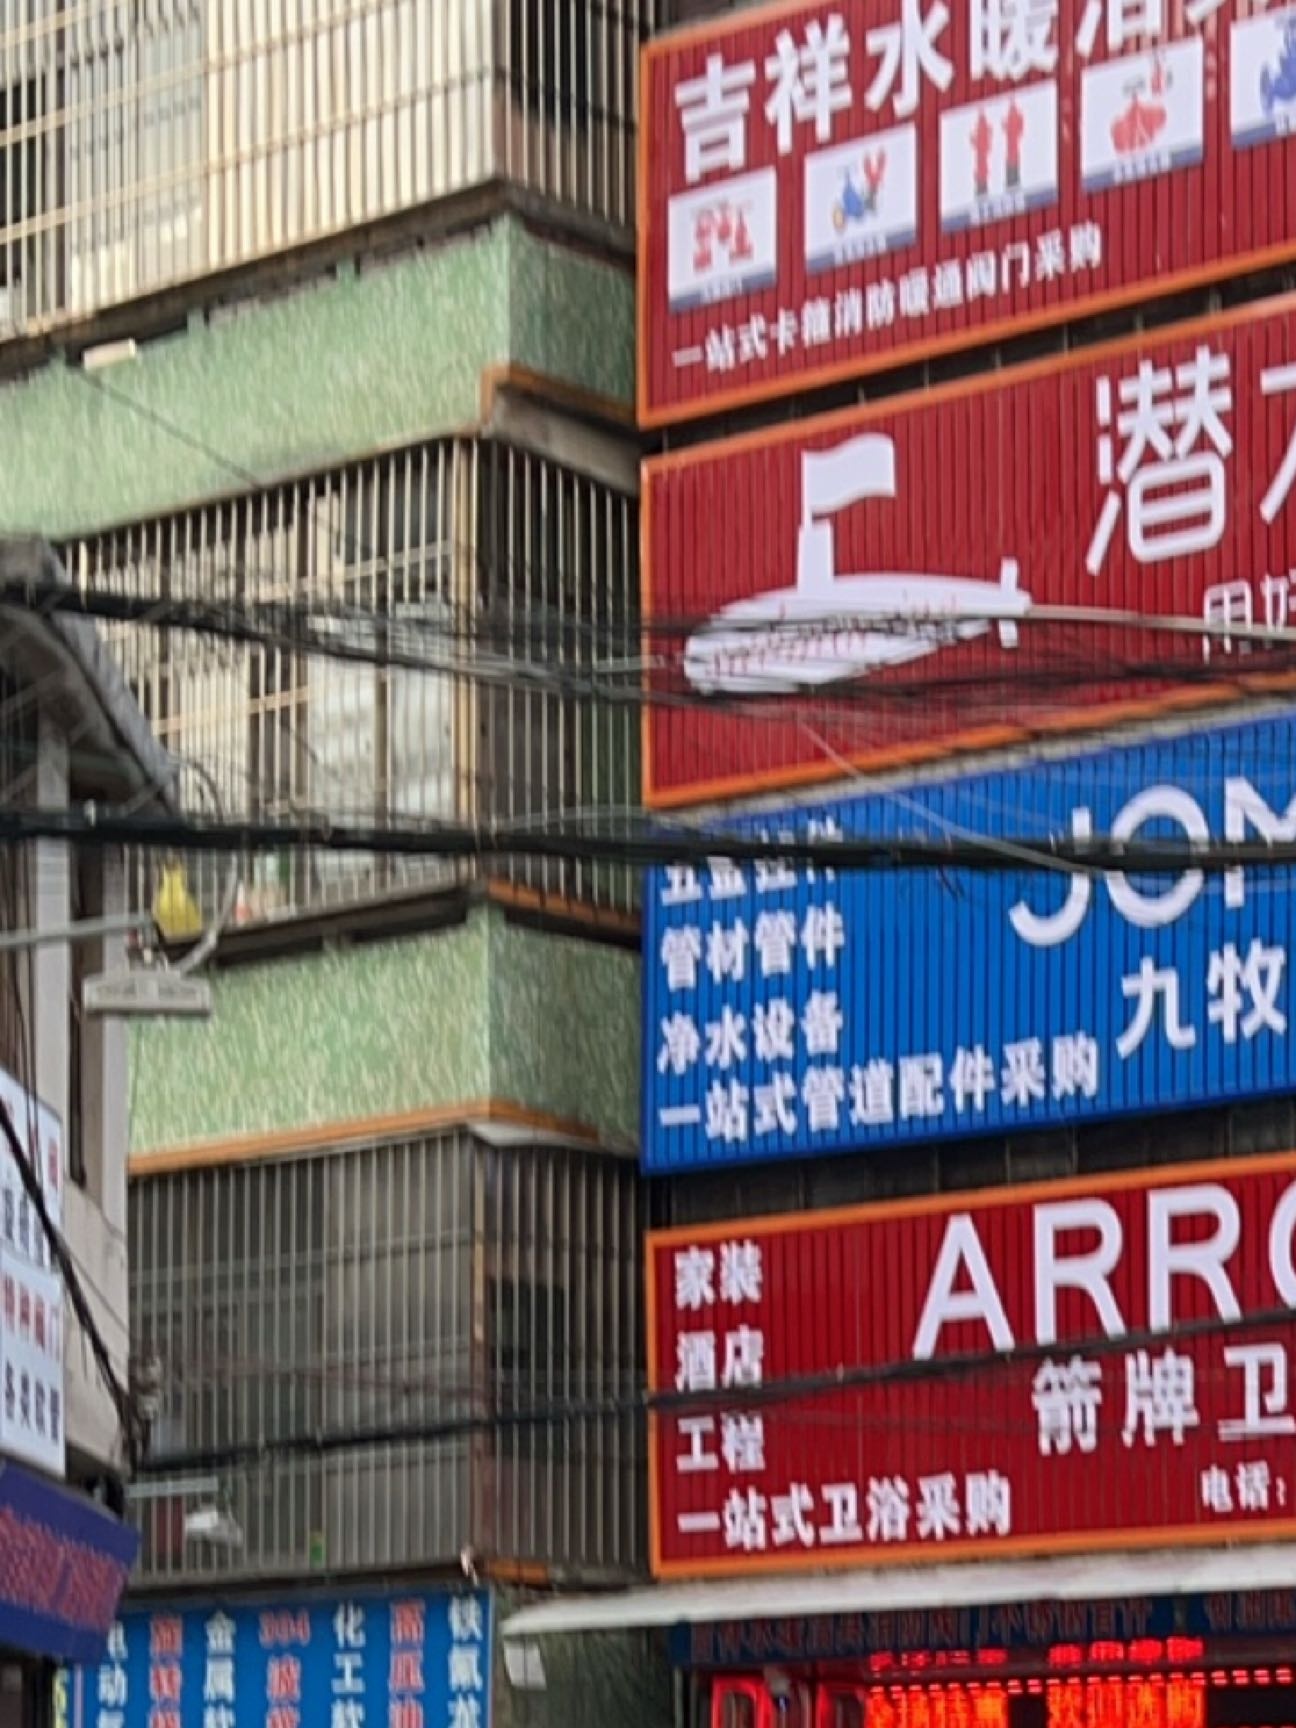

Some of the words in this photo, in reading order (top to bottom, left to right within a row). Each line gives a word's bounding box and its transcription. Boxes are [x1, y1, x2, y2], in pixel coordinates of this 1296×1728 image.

[675, 0, 1230, 183] 吉祥水暖
[660, 905, 845, 992] 管材管件
[657, 990, 843, 1075] 净水设备
[658, 1032, 1099, 1144] 一站式管道配件采购
[674, 1240, 764, 1310] 家装
[676, 1325, 764, 1392] 酒店
[676, 1412, 766, 1472] 工程
[678, 1469, 1012, 1550] 一站式卫浴采购
